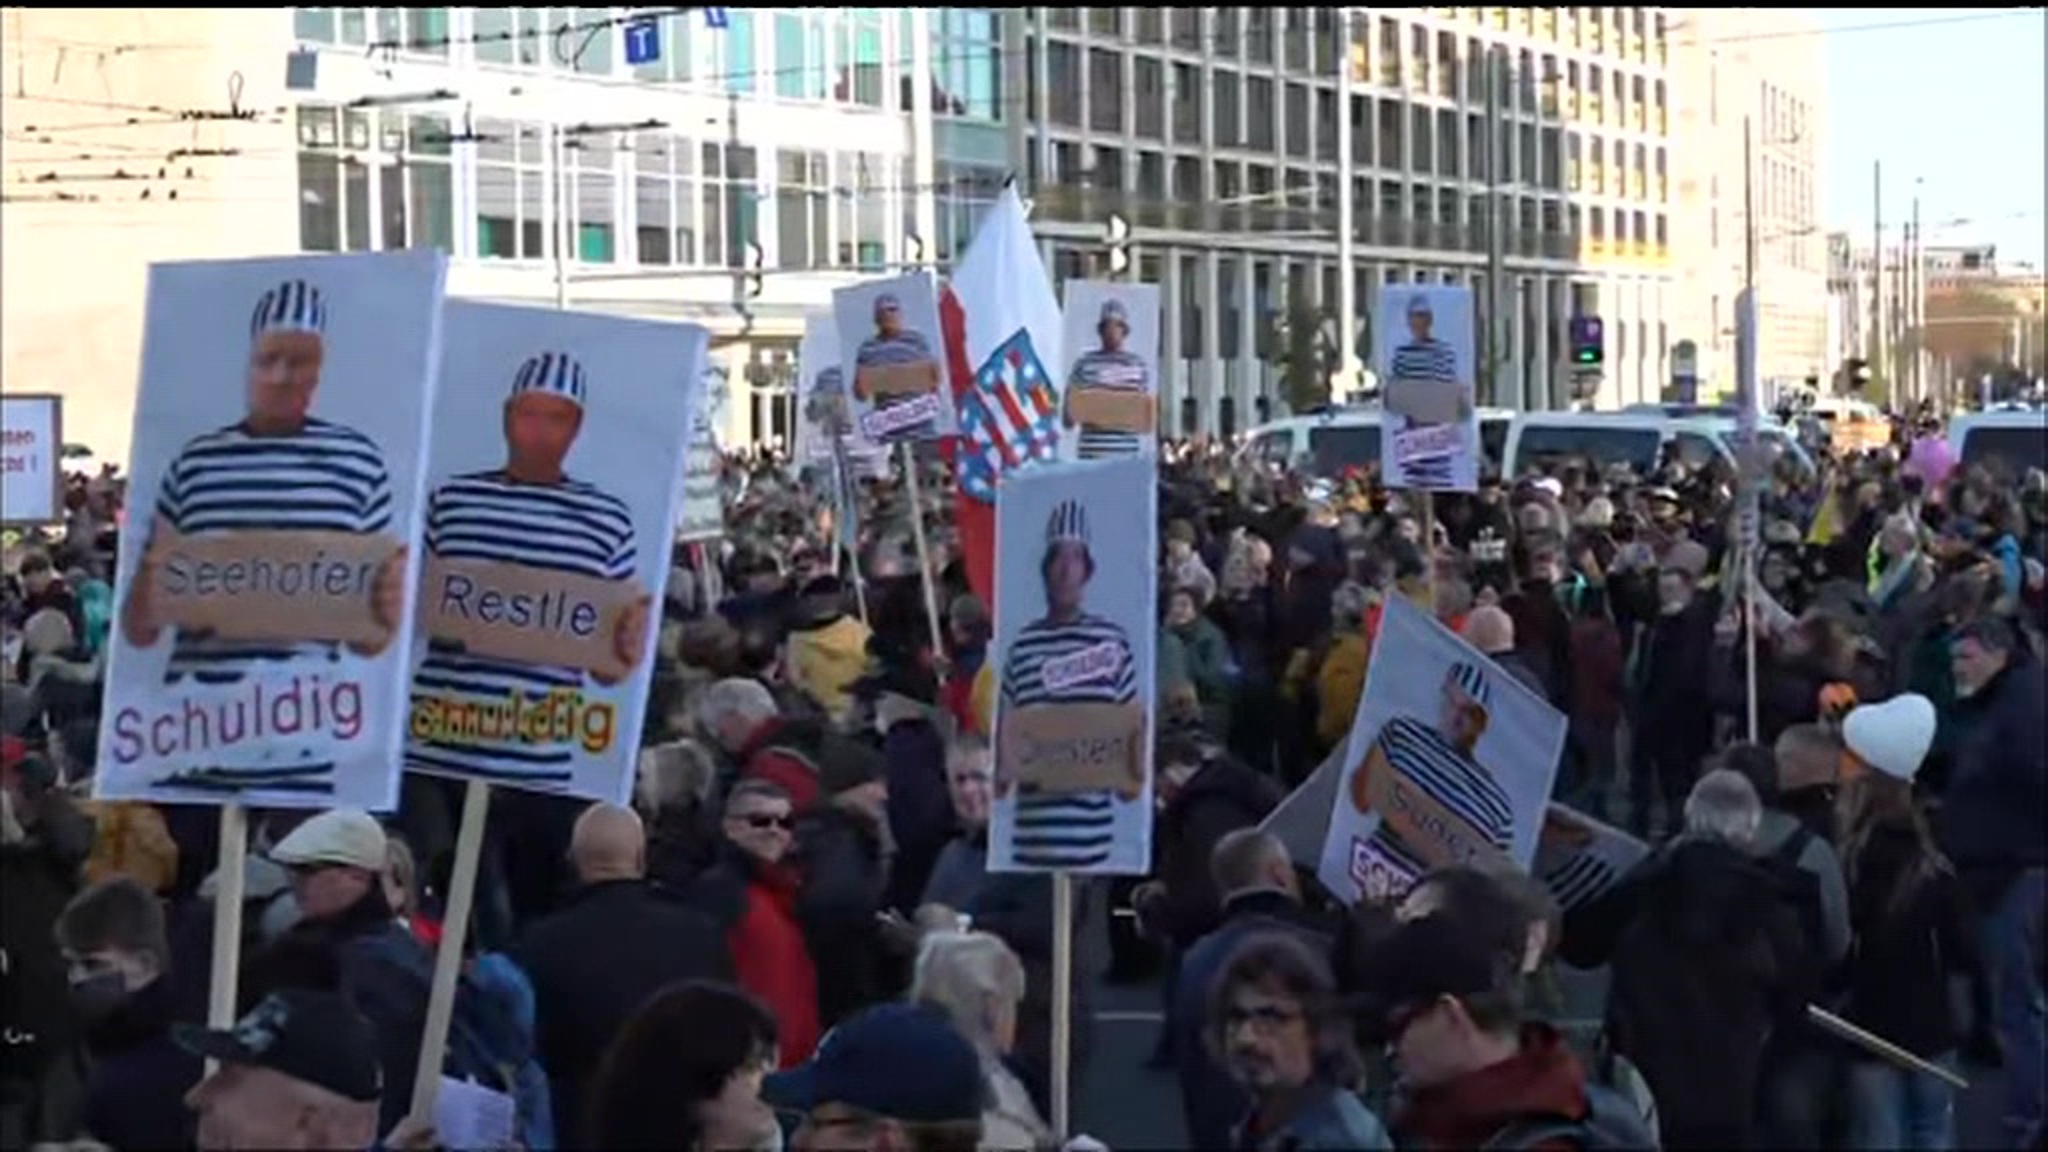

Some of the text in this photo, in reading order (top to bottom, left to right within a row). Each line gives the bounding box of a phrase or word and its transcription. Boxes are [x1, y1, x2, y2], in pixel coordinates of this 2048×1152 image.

[165, 550, 373, 596] Seehofer
[439, 573, 598, 637] Restle
[112, 679, 364, 764] Schuldig
